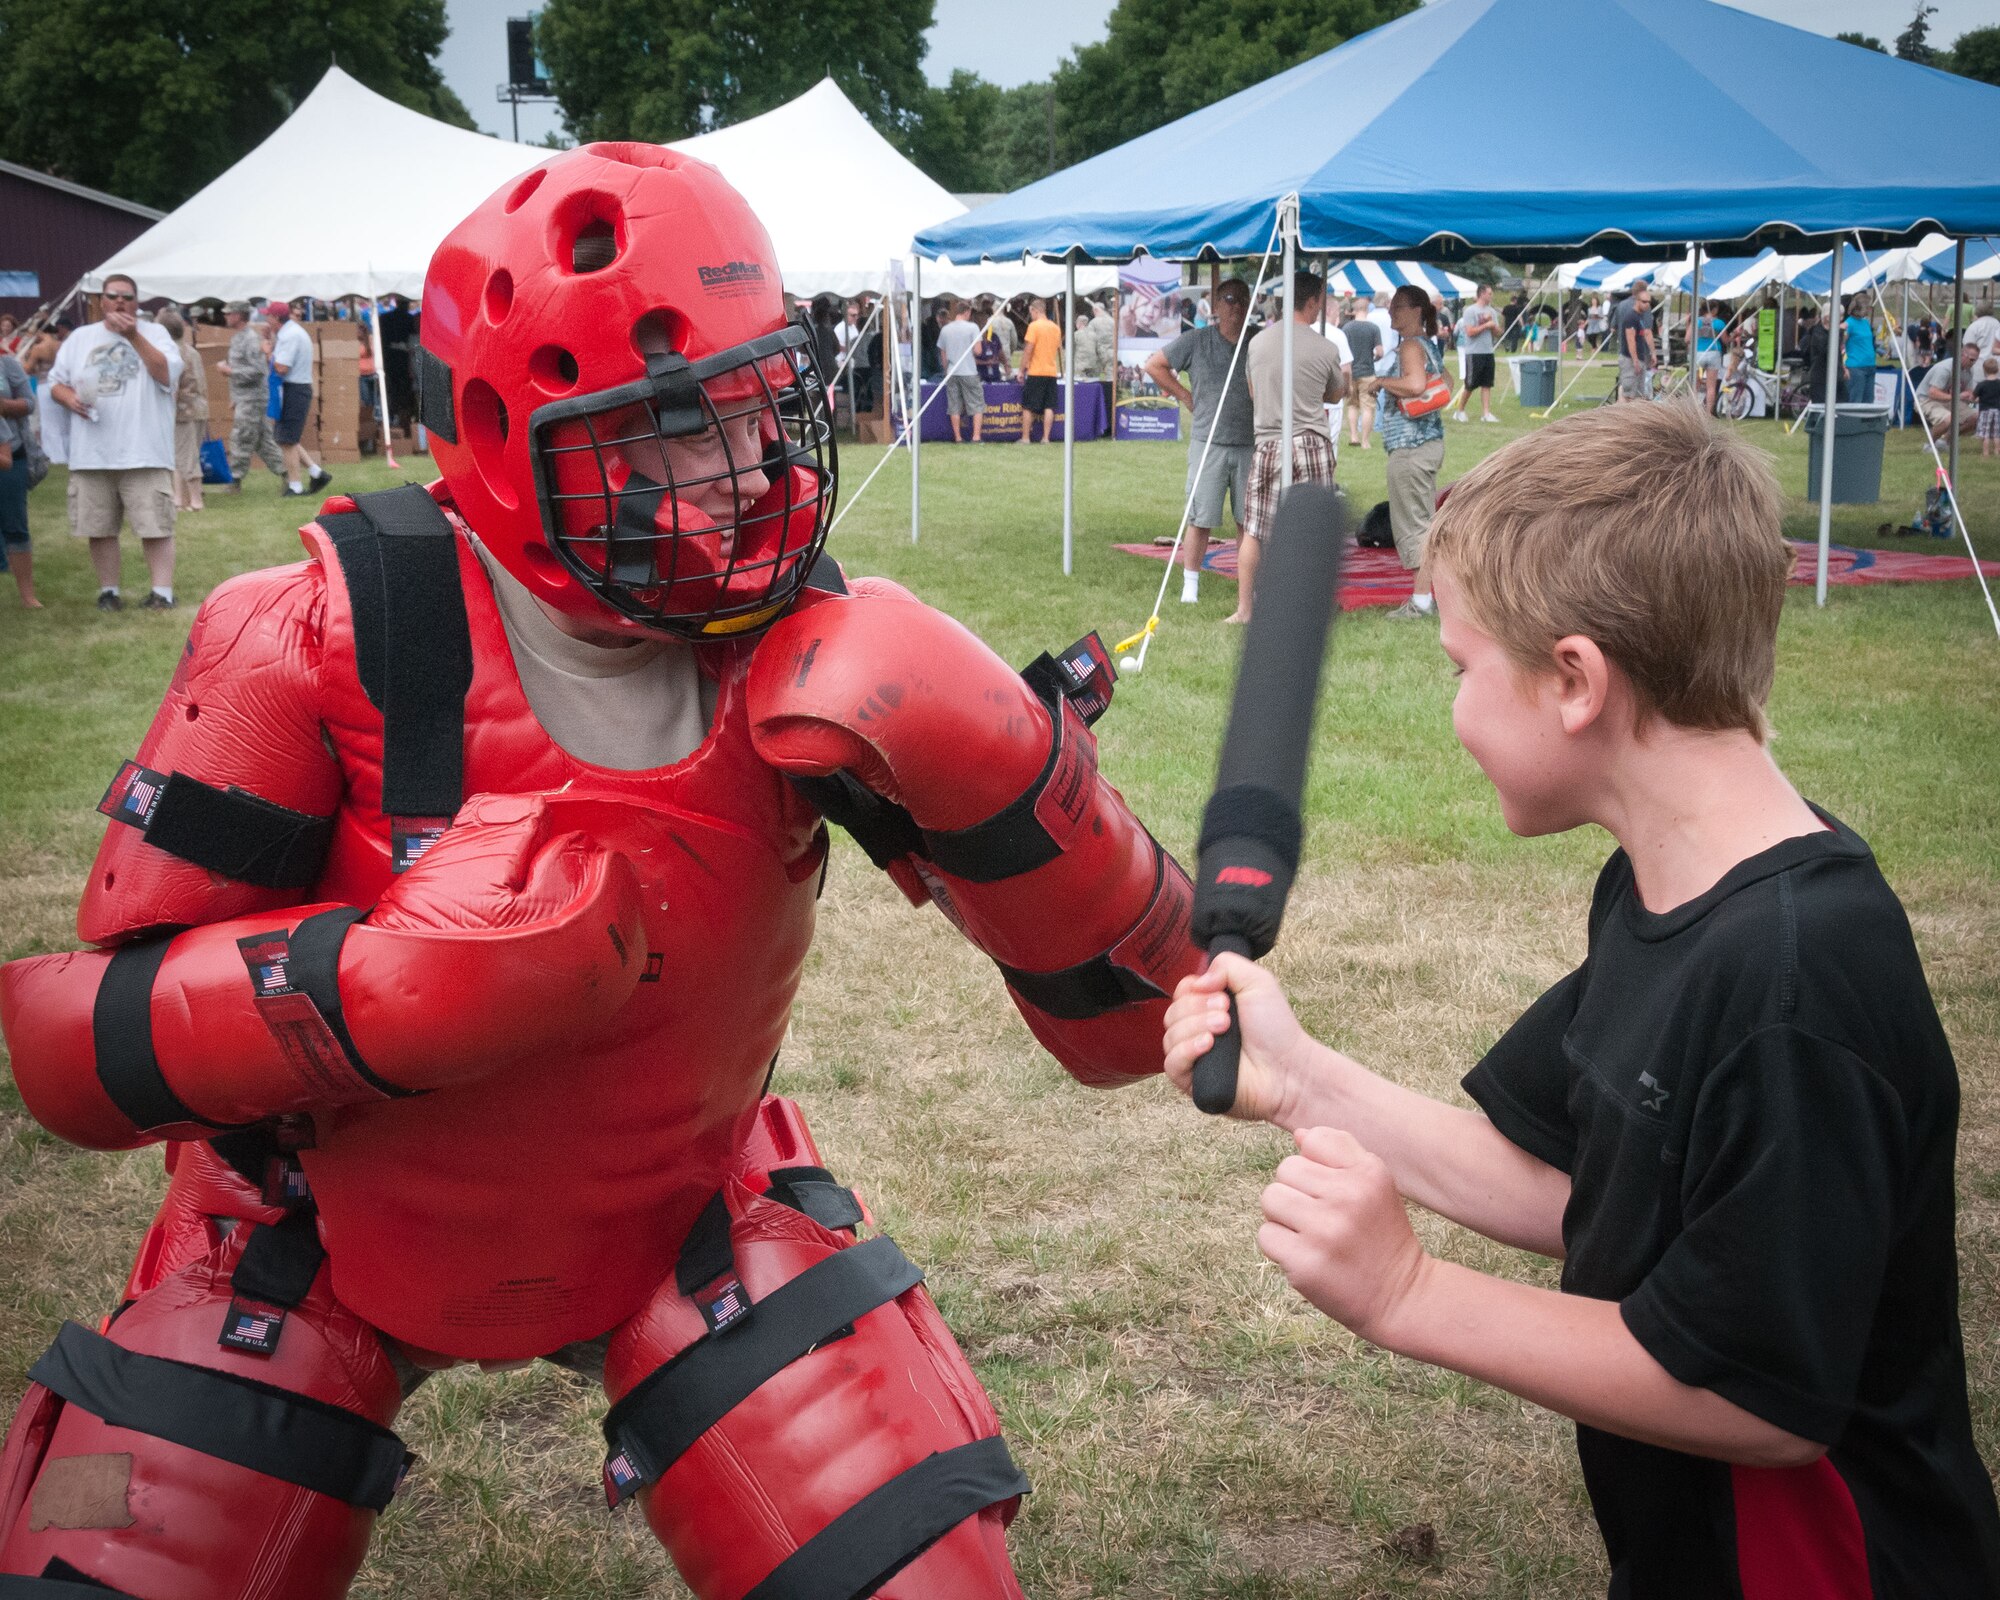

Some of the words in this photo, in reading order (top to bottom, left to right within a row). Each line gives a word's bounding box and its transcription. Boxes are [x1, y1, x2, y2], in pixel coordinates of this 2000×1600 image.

[697, 261, 761, 280] RedMan
[1002, 402, 1022, 414] Ribb
[143, 808, 155, 826] MADE
[226, 1333, 243, 1342] MADE
